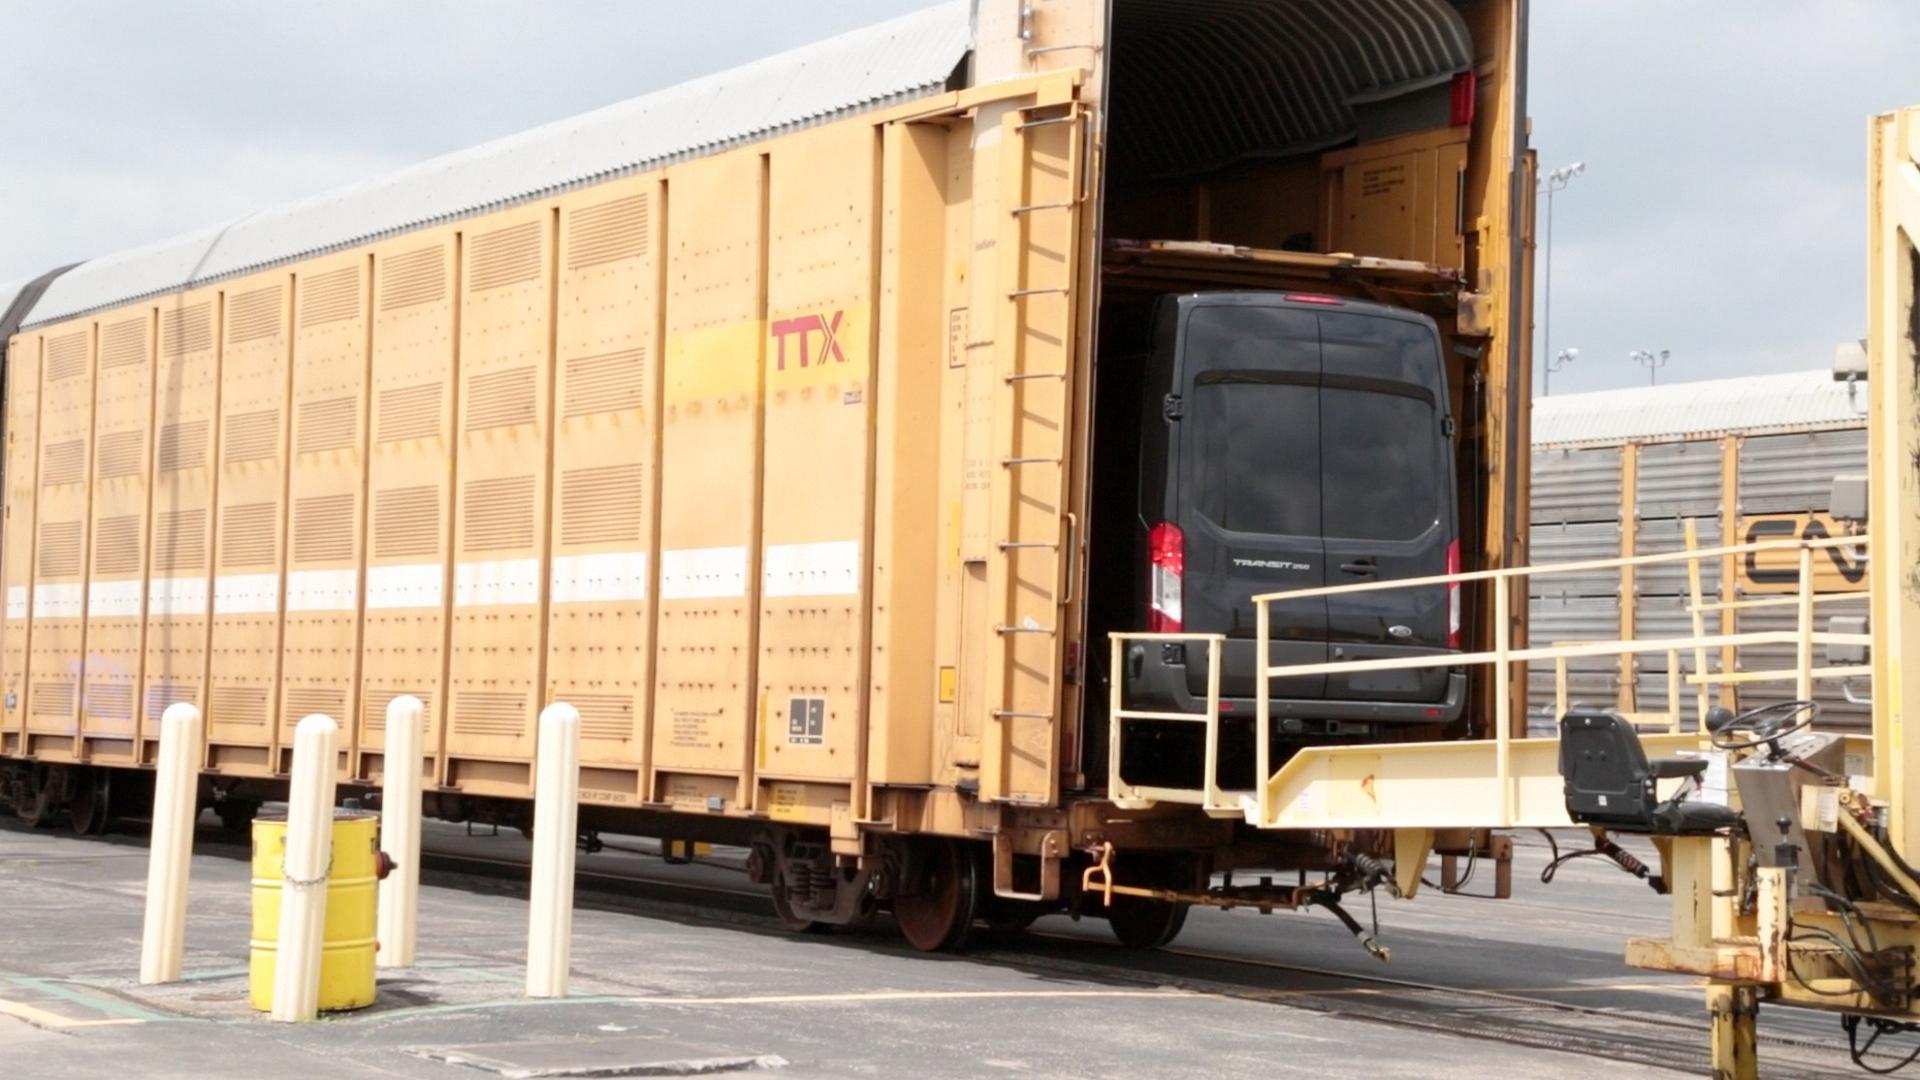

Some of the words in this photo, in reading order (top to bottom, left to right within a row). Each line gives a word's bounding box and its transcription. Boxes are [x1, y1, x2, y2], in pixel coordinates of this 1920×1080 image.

[771, 310, 845, 371] TTX
[1233, 558, 1292, 569] TRANSIT
[1745, 520, 1867, 583] CN
